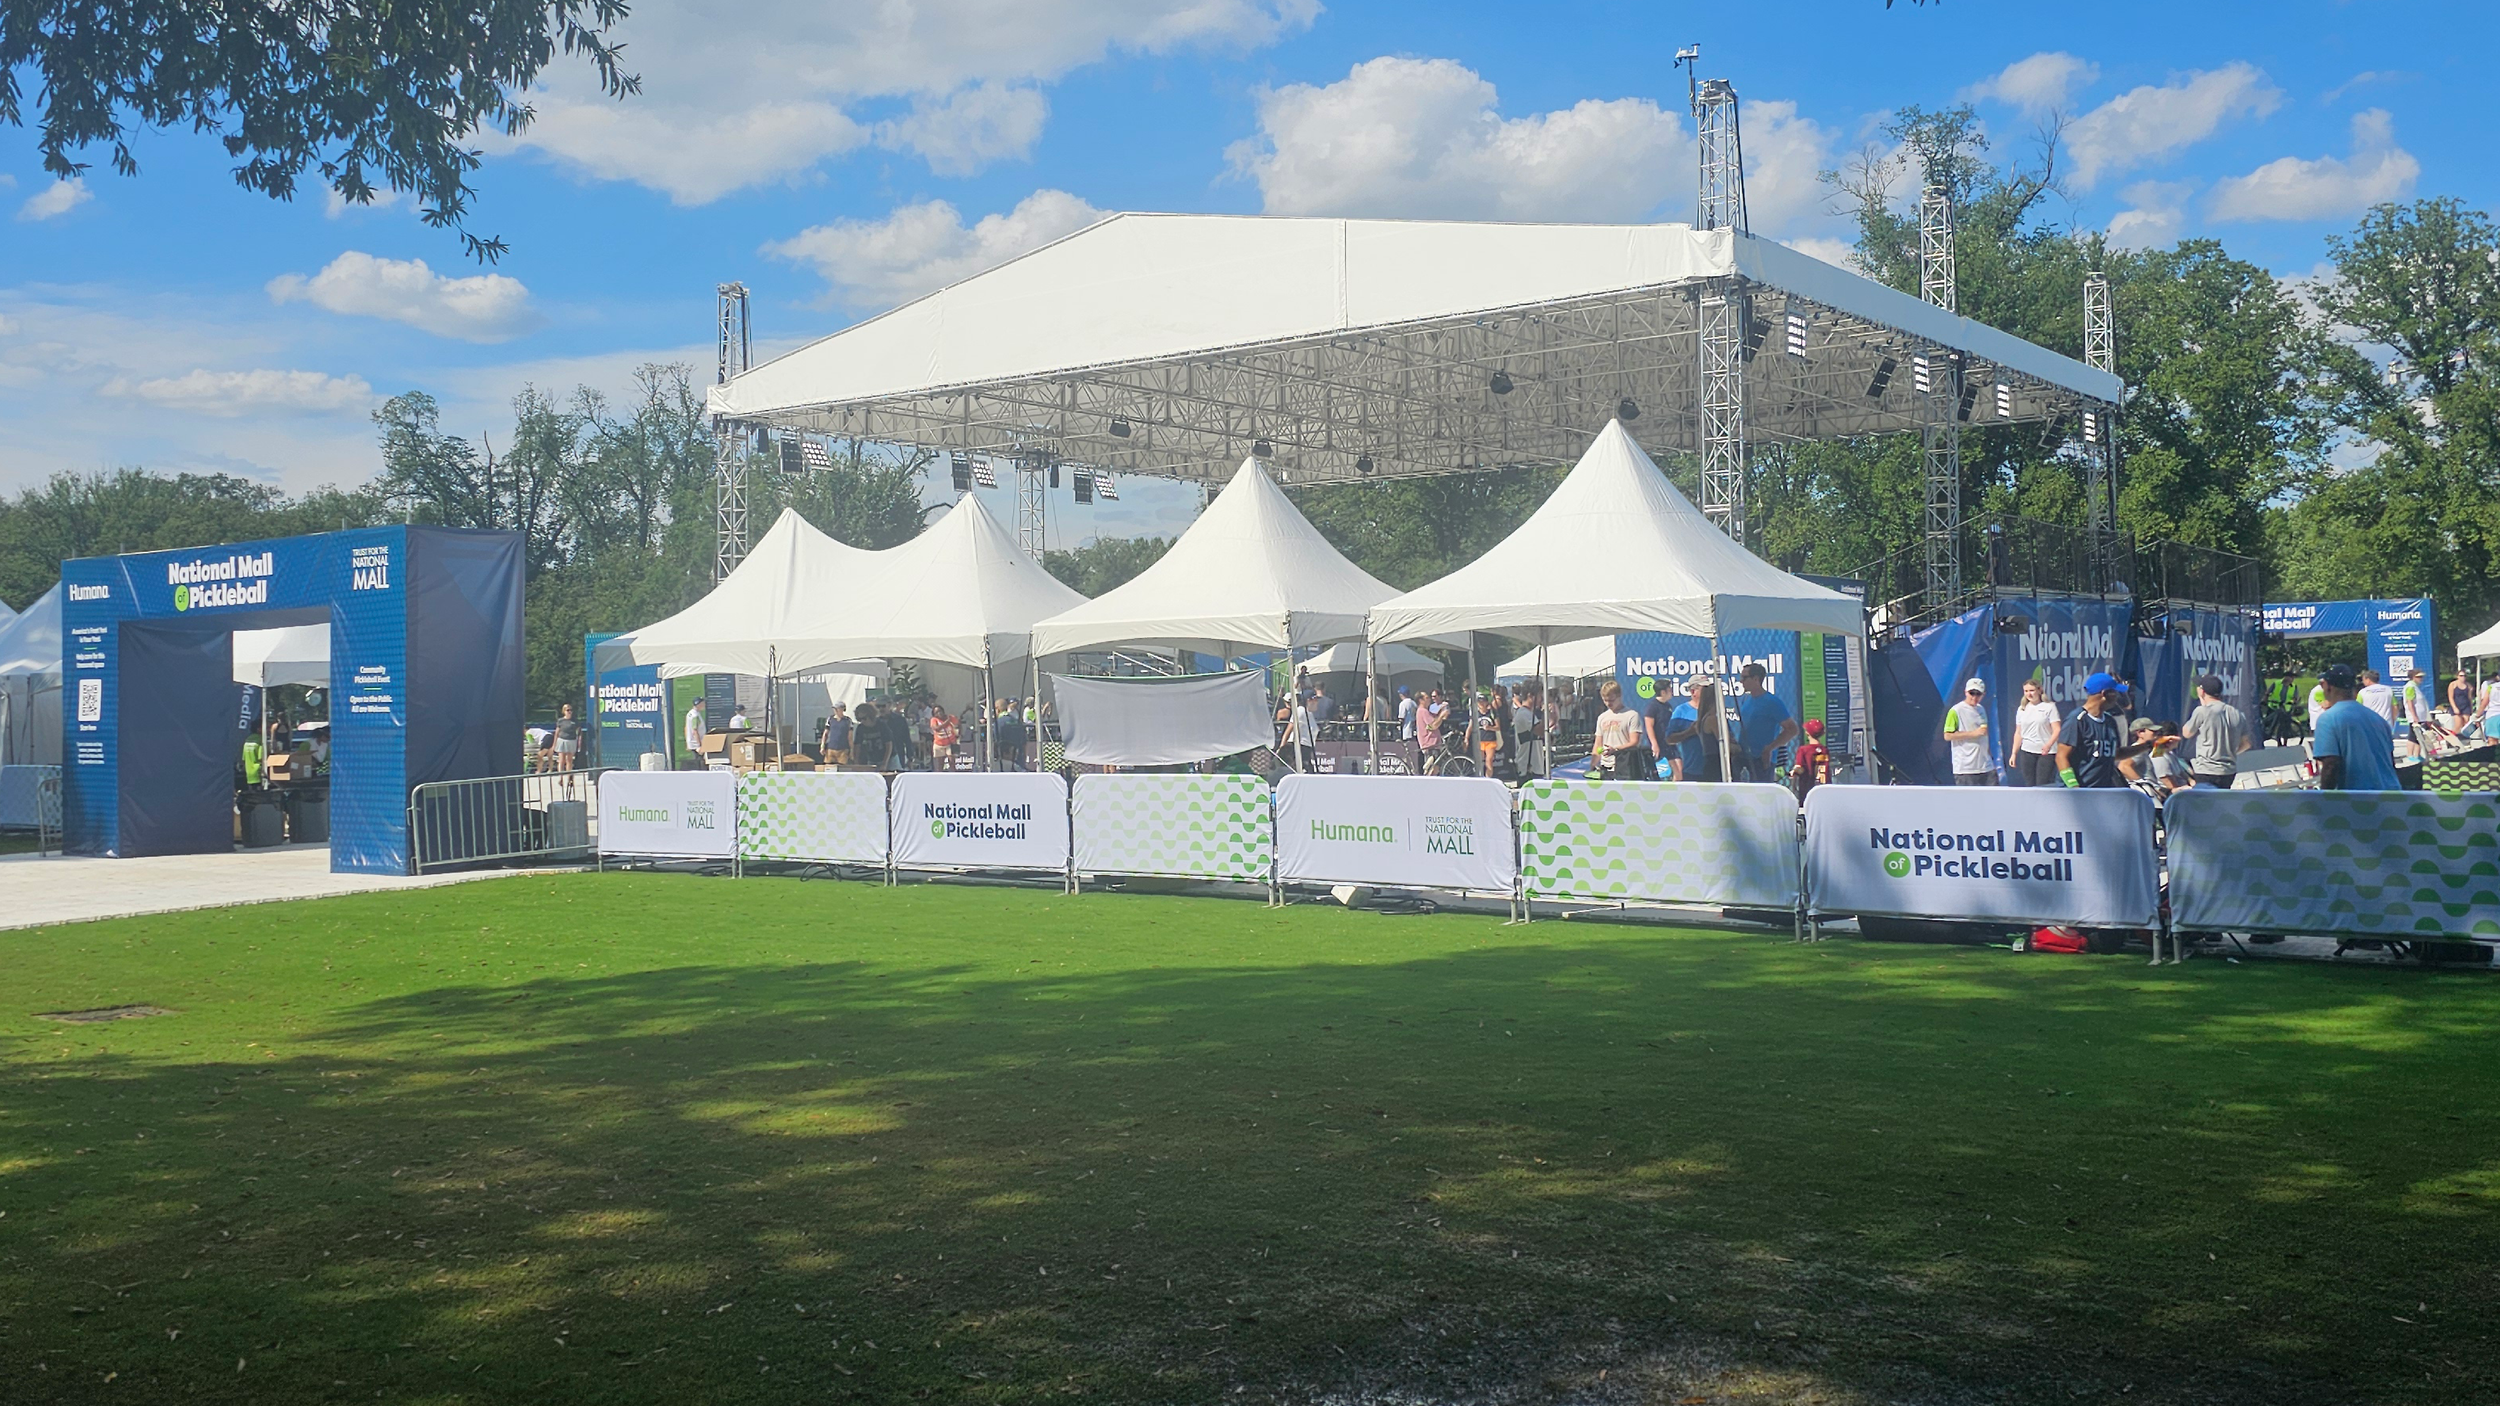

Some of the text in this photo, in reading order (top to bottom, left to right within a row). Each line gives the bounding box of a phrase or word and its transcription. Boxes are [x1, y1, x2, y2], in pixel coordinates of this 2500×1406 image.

[352, 546, 389, 556] TRUST FOR THE
[168, 552, 273, 585] National Mall
[352, 555, 389, 568] NATIONAL
[353, 566, 390, 590] MALL
[177, 580, 267, 609] of Pickleball
[2284, 606, 2316, 618] Mall
[638, 683, 662, 698] Mall
[1640, 681, 1653, 692] of
[604, 698, 659, 713] Pickleball
[687, 806, 715, 815] NATIONAL
[924, 802, 1032, 820] National Mall
[687, 814, 715, 830] MALL
[1425, 816, 1473, 825] TRUST FOR THE
[932, 821, 1026, 840] of Pickleball
[1425, 824, 1474, 835] NATIONAL
[1426, 834, 1475, 855] MALL
[1870, 827, 2084, 855] National Mall
[1888, 854, 2073, 882] of Pickleball
